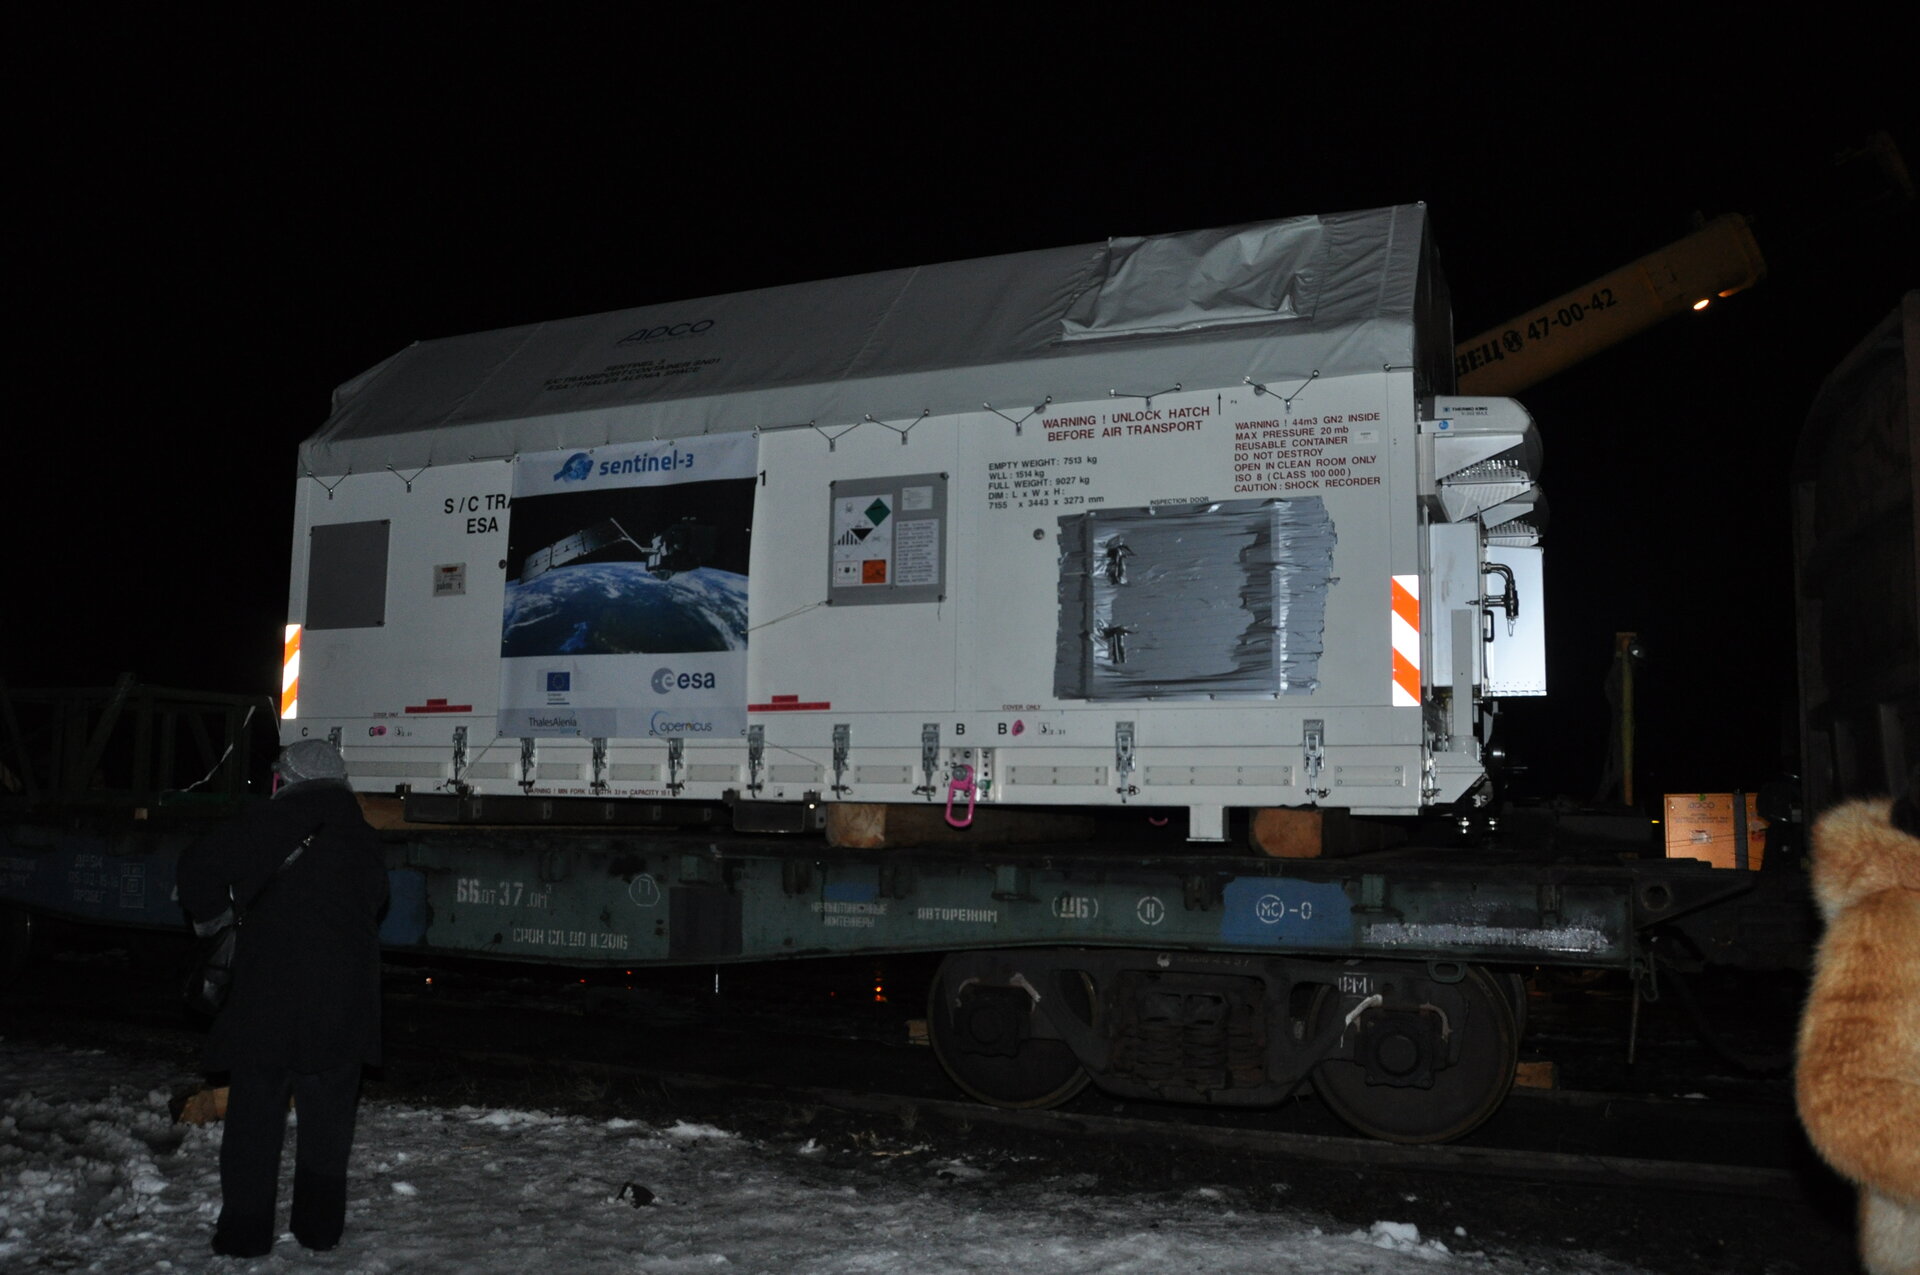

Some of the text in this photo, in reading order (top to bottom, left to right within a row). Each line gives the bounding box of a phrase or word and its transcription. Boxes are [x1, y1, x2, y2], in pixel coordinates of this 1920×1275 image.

[1528, 288, 1618, 340] 47-00-42
[1042, 415, 1096, 429] WARNING
[1112, 410, 1161, 423] UNLOCK
[1168, 406, 1210, 419] HATCH
[1235, 419, 1279, 431] WARNING
[1292, 416, 1318, 426] 44m3
[1323, 415, 1343, 424] GN2
[1348, 412, 1380, 422] INSIDE
[1047, 420, 1203, 442] BEFORE AIR TRANSPORT
[1235, 425, 1349, 441] MAX PRESSURE 20 mb
[1235, 436, 1348, 451] REUSABLE CONTAINER
[1234, 448, 1324, 462] DO NOT DESTROY
[599, 450, 694, 476] sentinel-3
[988, 461, 1018, 471] EMPTY
[1064, 457, 1082, 465] 7513
[1087, 456, 1098, 465] kg
[1234, 455, 1377, 472] OPEN IN CLEAN ROOM ONLY
[1034, 470, 1045, 478] kg
[1235, 473, 1251, 483] ISO
[1256, 473, 1262, 481] 8
[1310, 469, 1326, 478] 100
[988, 482, 1009, 490] FULL
[1055, 477, 1076, 486] 9027
[1080, 476, 1090, 485] kg
[1284, 479, 1319, 490] SHOCK
[1325, 476, 1381, 488] RECORDER
[1012, 491, 1018, 499] L
[1032, 489, 1041, 497] W
[1064, 496, 1084, 505] 3273
[467, 517, 498, 534] ESA
[677, 672, 715, 689] esa
[1002, 703, 1041, 712] COVER ONLY
[651, 711, 713, 736] Copernicus
[956, 723, 1007, 735] B B
[302, 727, 309, 737] C
[630, 788, 659, 796] CAPACITY
[917, 907, 998, 923] АВТОРЕЖИМ
[513, 927, 544, 945] СРОК
